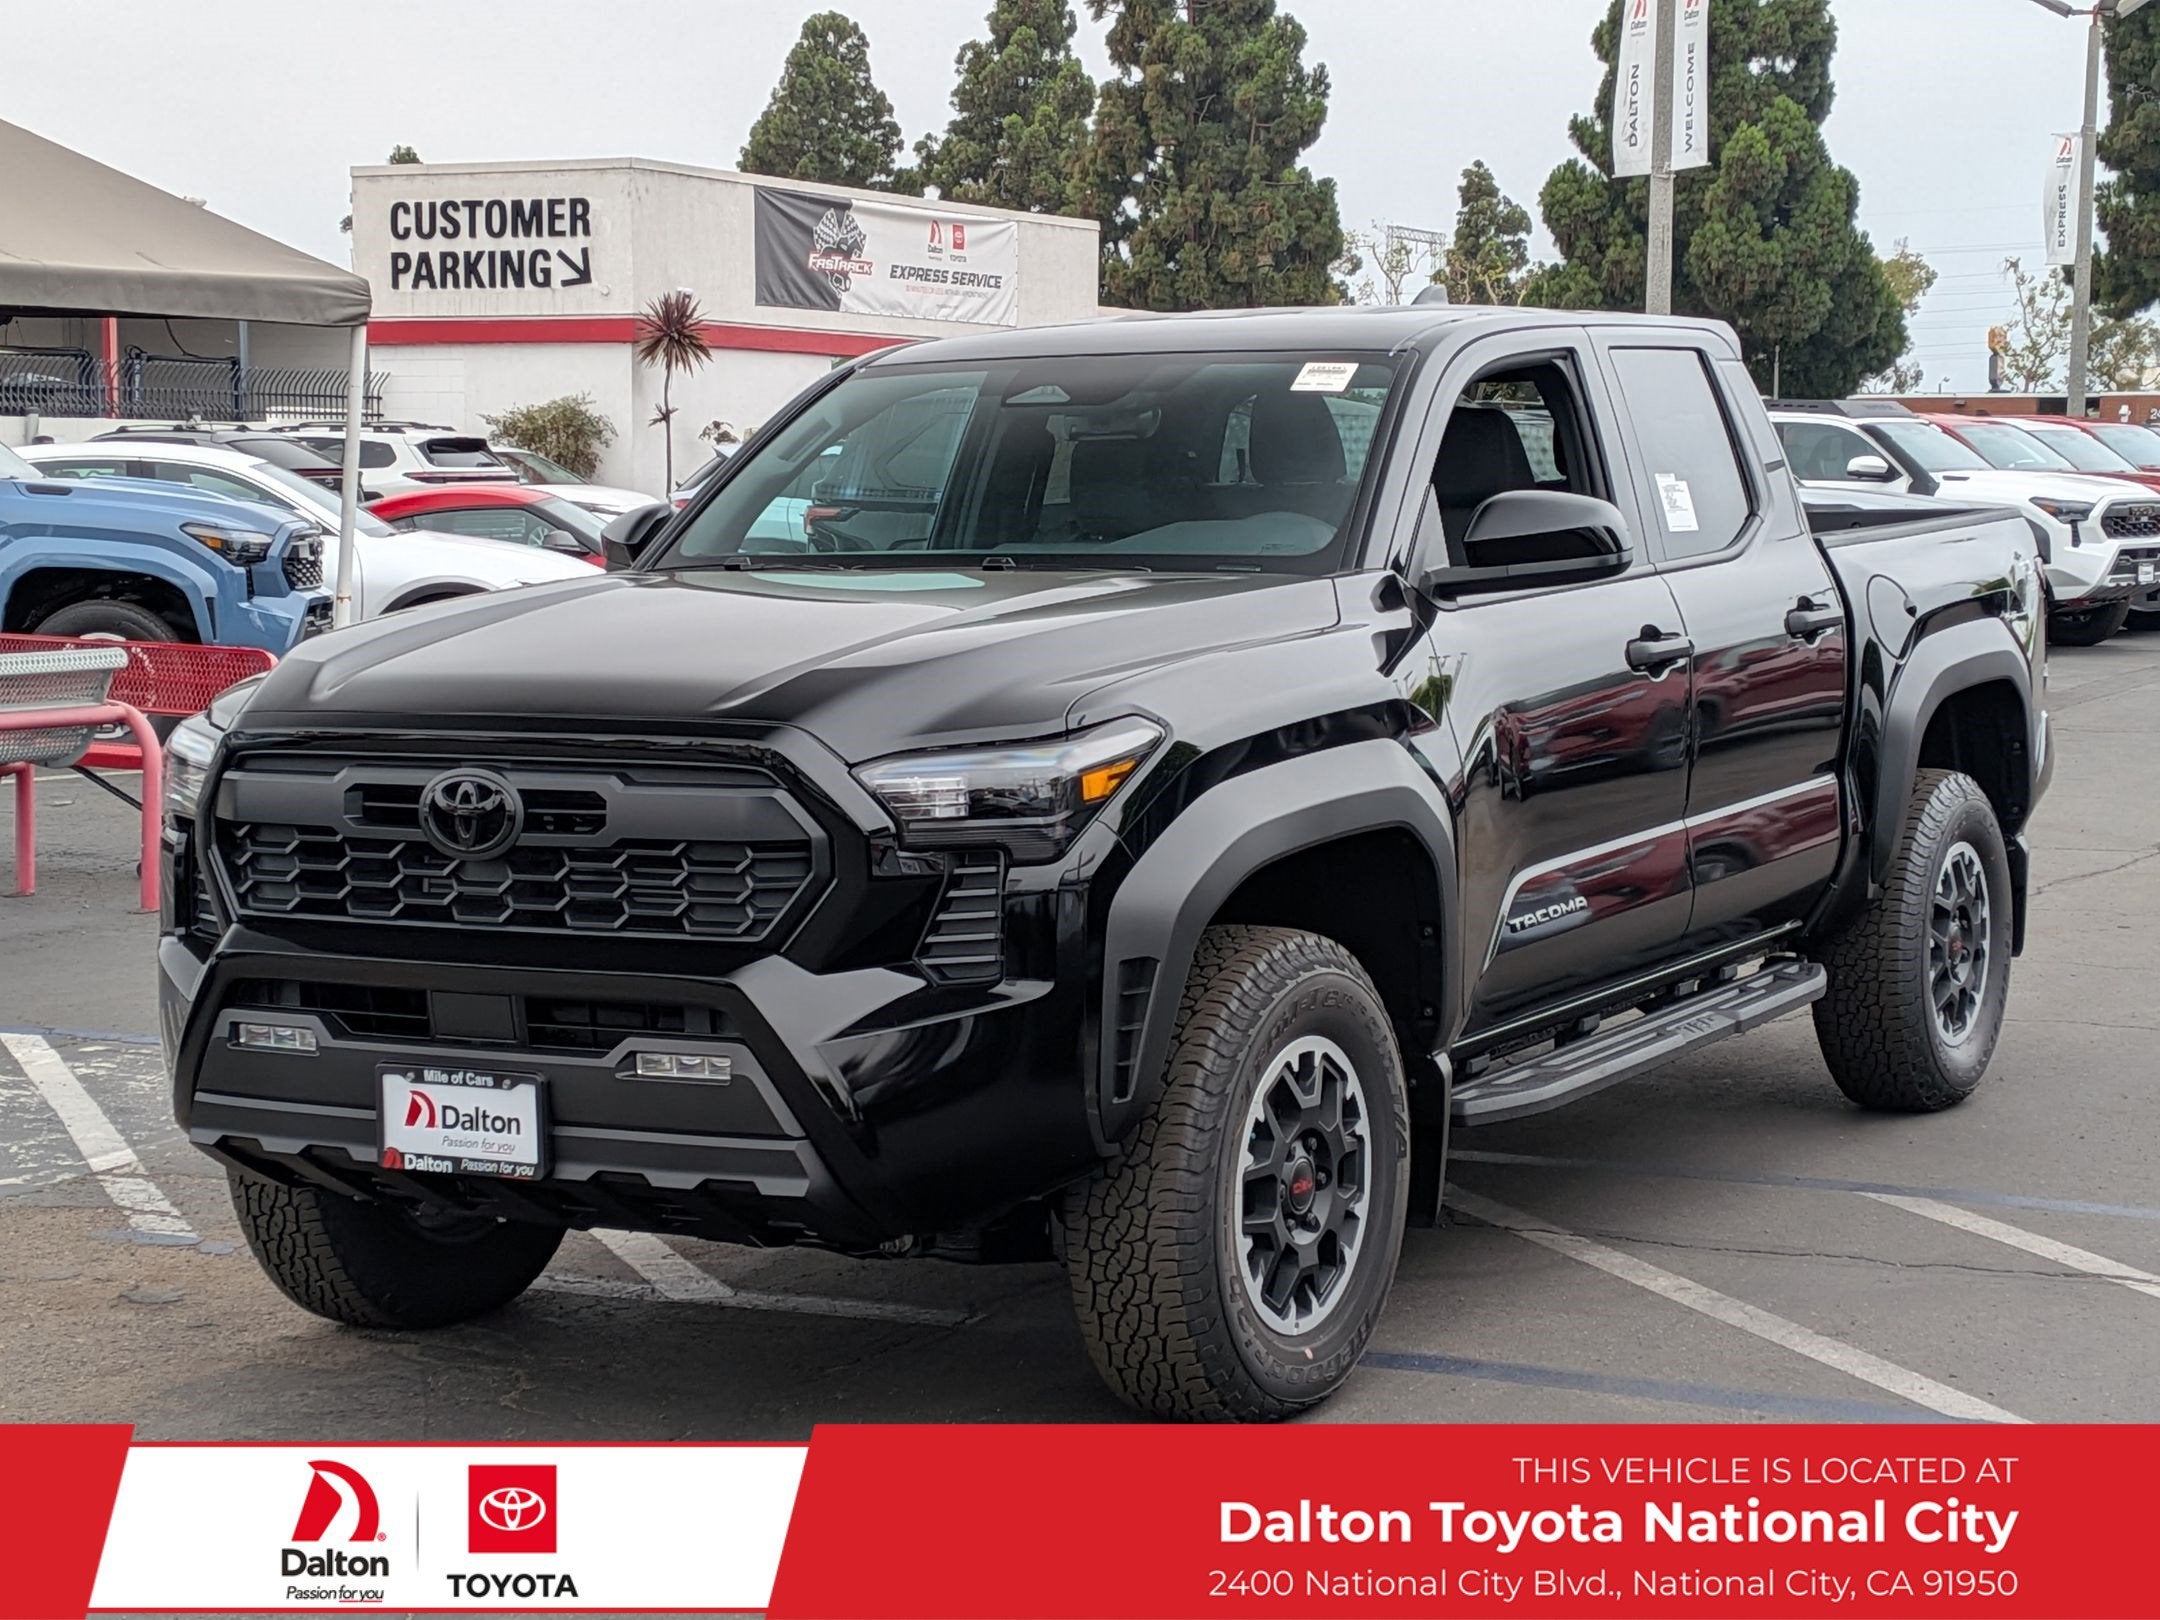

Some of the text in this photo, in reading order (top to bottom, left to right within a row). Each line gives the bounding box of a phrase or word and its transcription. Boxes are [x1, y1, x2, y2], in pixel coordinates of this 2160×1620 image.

[1629, 64, 1640, 147] DALTON
[1685, 42, 1695, 153] WELCOME
[390, 197, 591, 240] CUSTOMER
[2058, 184, 2067, 247] EXPRESS
[391, 249, 551, 290] PARKING
[890, 264, 1003, 289] EXPRESS SERVICE
[1507, 896, 1588, 931] TACOMA
[423, 1069, 494, 1087] Mile of Cars
[441, 1104, 521, 1135] Dalton
[441, 1135, 516, 1152] Passion for you
[404, 1154, 535, 1177] Dalton Passion for you
